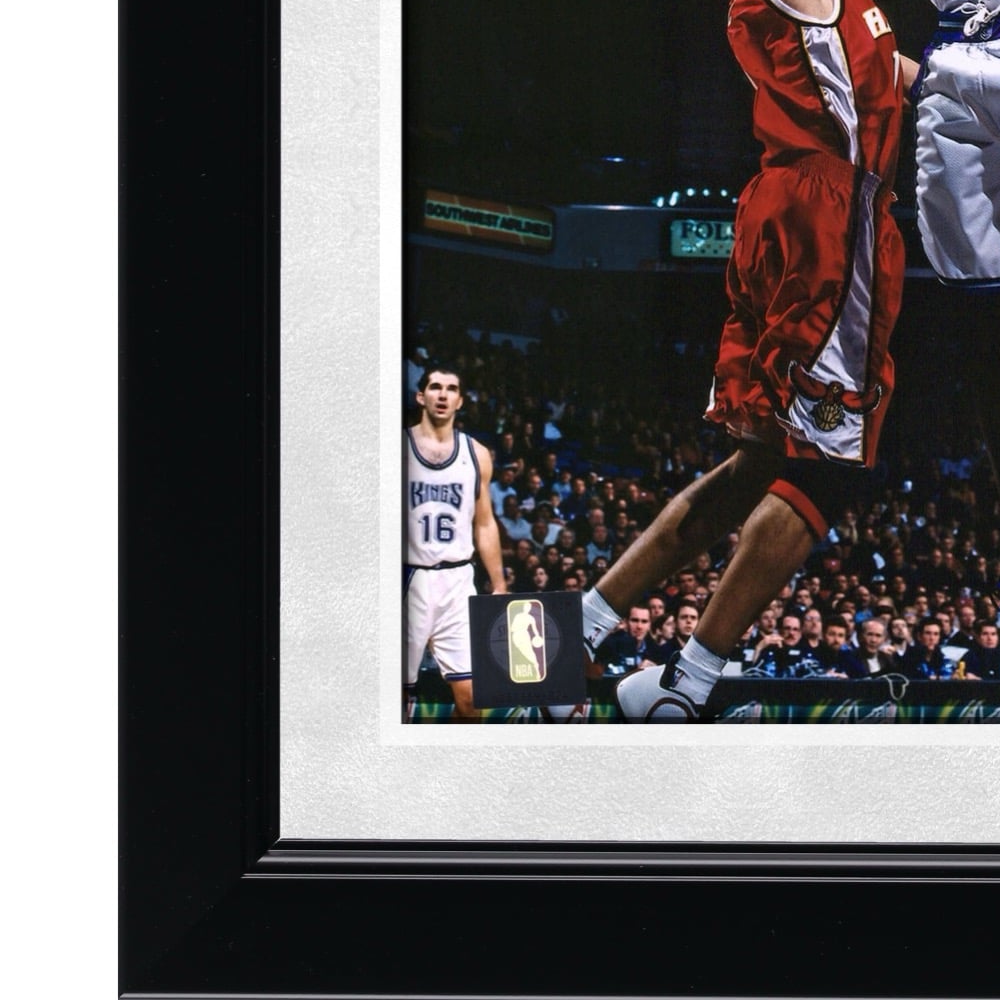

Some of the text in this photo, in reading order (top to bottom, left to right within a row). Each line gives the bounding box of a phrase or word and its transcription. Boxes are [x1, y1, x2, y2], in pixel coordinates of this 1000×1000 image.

[410, 481, 463, 511] KINGS
[418, 514, 454, 544] 16
[514, 664, 533, 679] NBA
